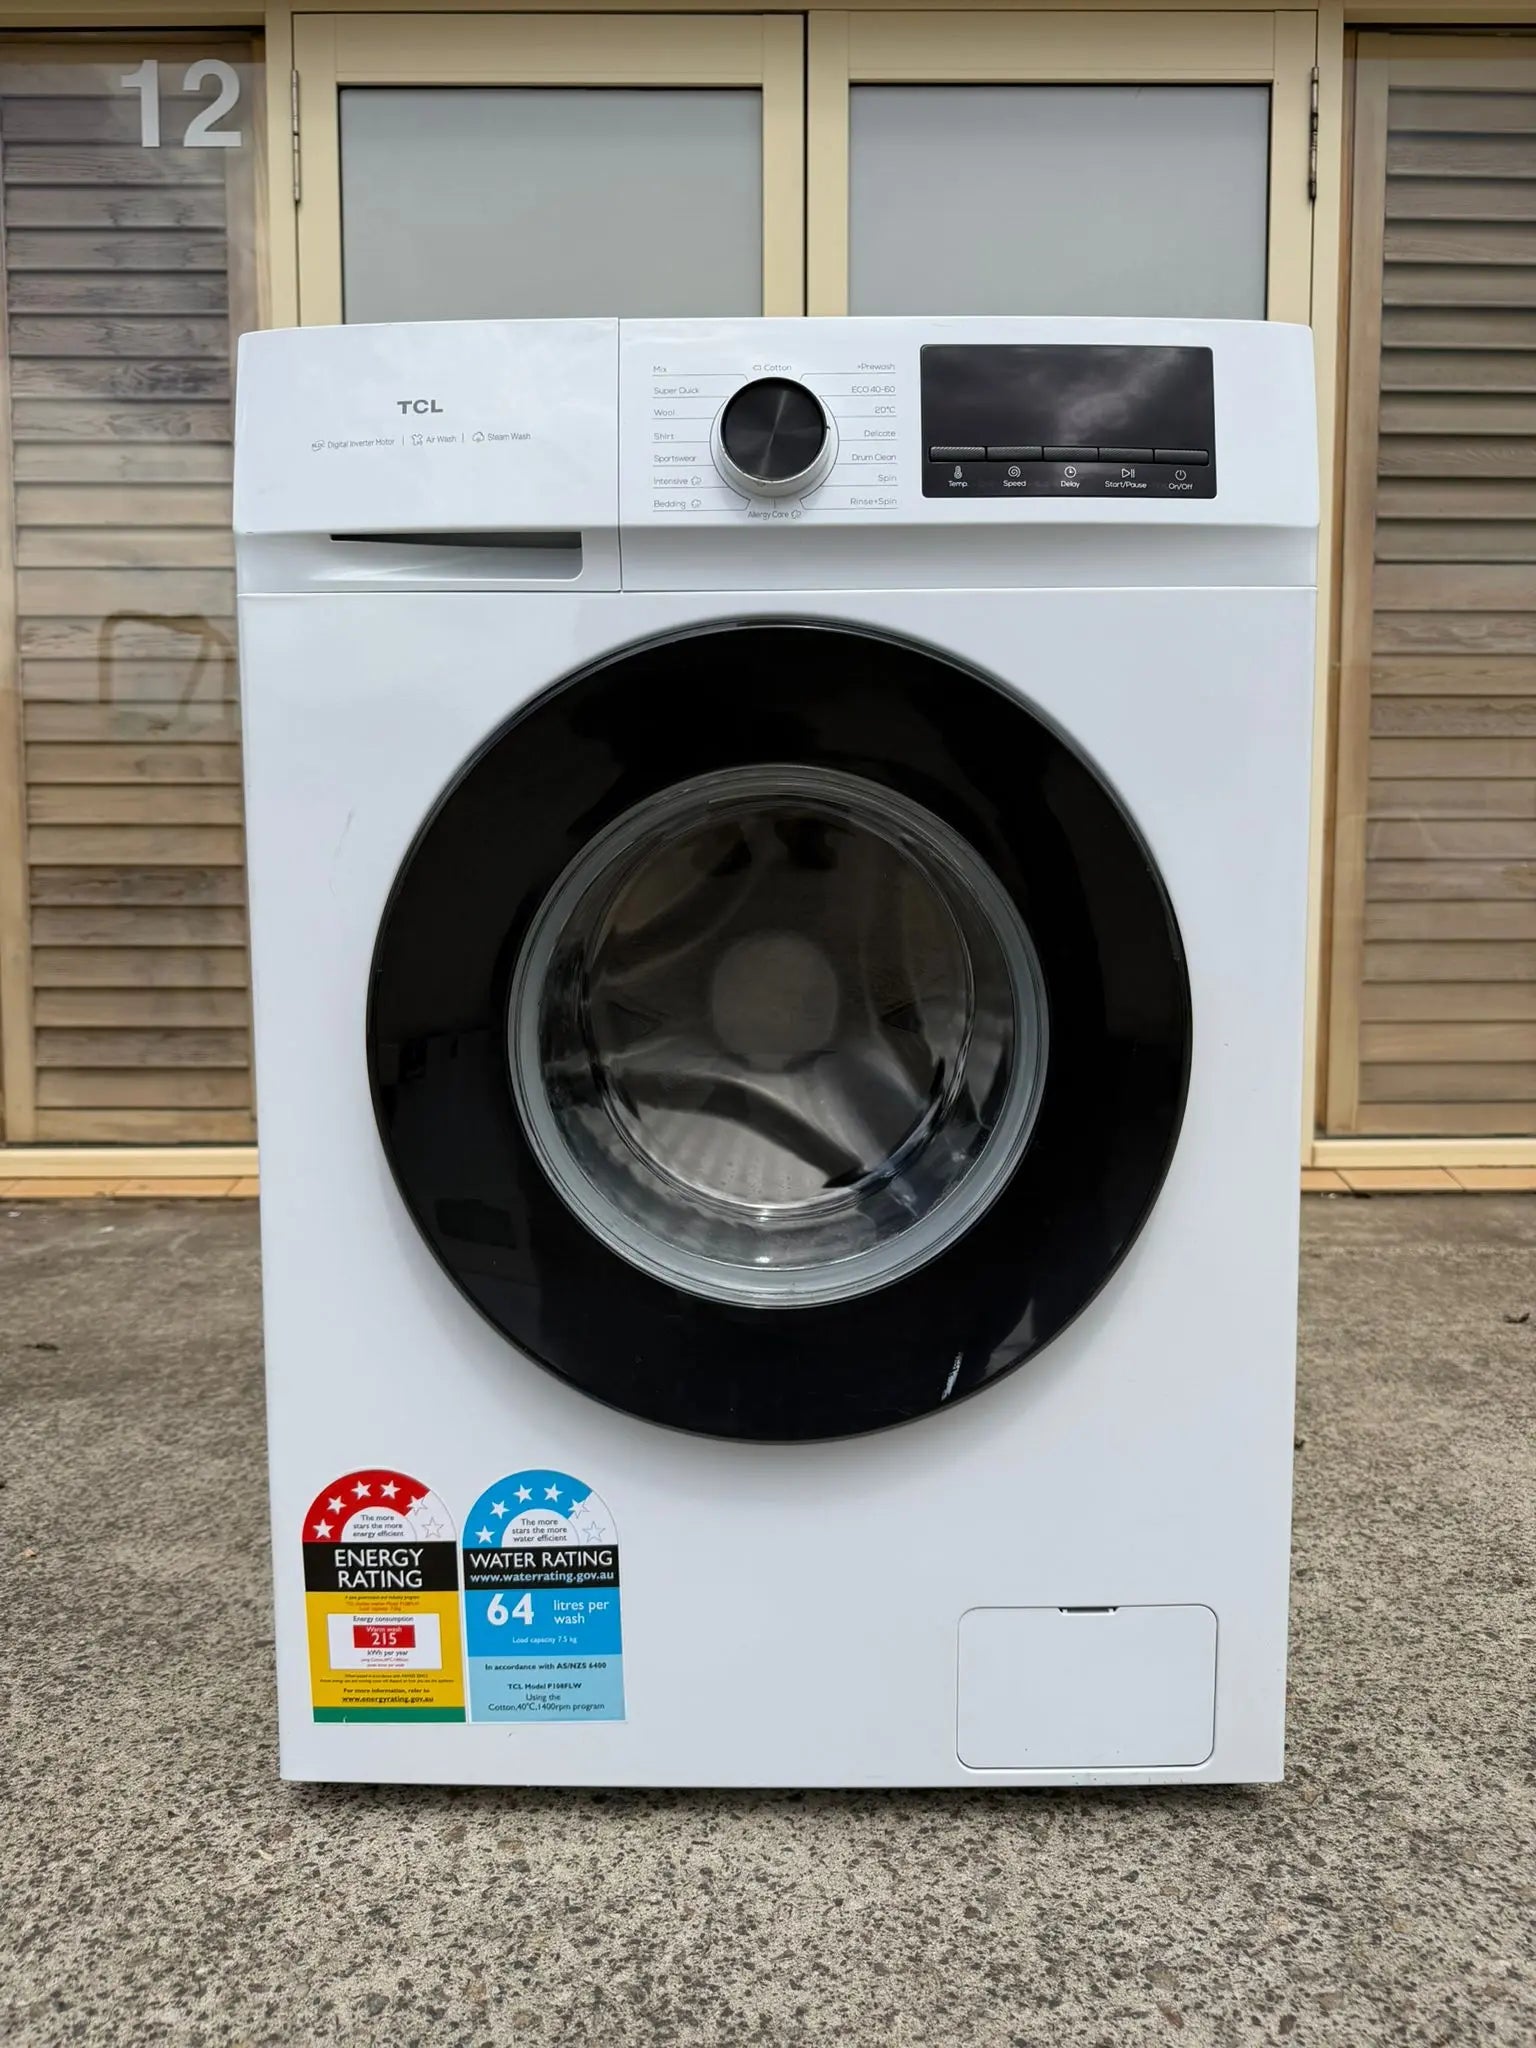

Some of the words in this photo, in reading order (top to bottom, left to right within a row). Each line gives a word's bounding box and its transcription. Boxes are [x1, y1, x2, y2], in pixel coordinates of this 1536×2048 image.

[120, 59, 241, 147] 12
[653, 387, 677, 395] Super
[851, 385, 870, 393] ECO
[871, 385, 896, 393] 40-60
[397, 399, 443, 414] TCL
[874, 406, 896, 414] 20°C
[426, 435, 435, 443] Air
[437, 435, 457, 443] Wash
[487, 432, 510, 441] Steam
[511, 432, 531, 440] Wash
[654, 432, 674, 440] Shirt
[328, 440, 349, 449] Digital
[350, 439, 374, 447] Inverter
[375, 438, 395, 447] Motor
[654, 455, 696, 463] Sportswear
[654, 477, 688, 485] Intensive
[878, 475, 897, 484] Spin
[1003, 479, 1026, 488] Speed
[1060, 480, 1080, 489] Delay
[1105, 480, 1147, 489] Start/Pause
[1168, 482, 1193, 490] On/Off
[654, 500, 686, 509] Bedding
[850, 498, 897, 507] Rinse+Spin
[748, 511, 771, 520] Allergy
[334, 1548, 423, 1567] ENERGY
[469, 1553, 537, 1569] WATER
[541, 1551, 612, 1567] RATING
[338, 1570, 422, 1588] RATING
[470, 1570, 614, 1583] www.waterrating.gov.au
[487, 1593, 534, 1626] 64
[553, 1600, 584, 1611] litres
[588, 1601, 610, 1614] per
[554, 1613, 584, 1624] wash
[372, 1633, 397, 1645] 215
[556, 1662, 587, 1670] AS/NZS
[525, 1694, 547, 1702] Using
[572, 1702, 605, 1711] program
